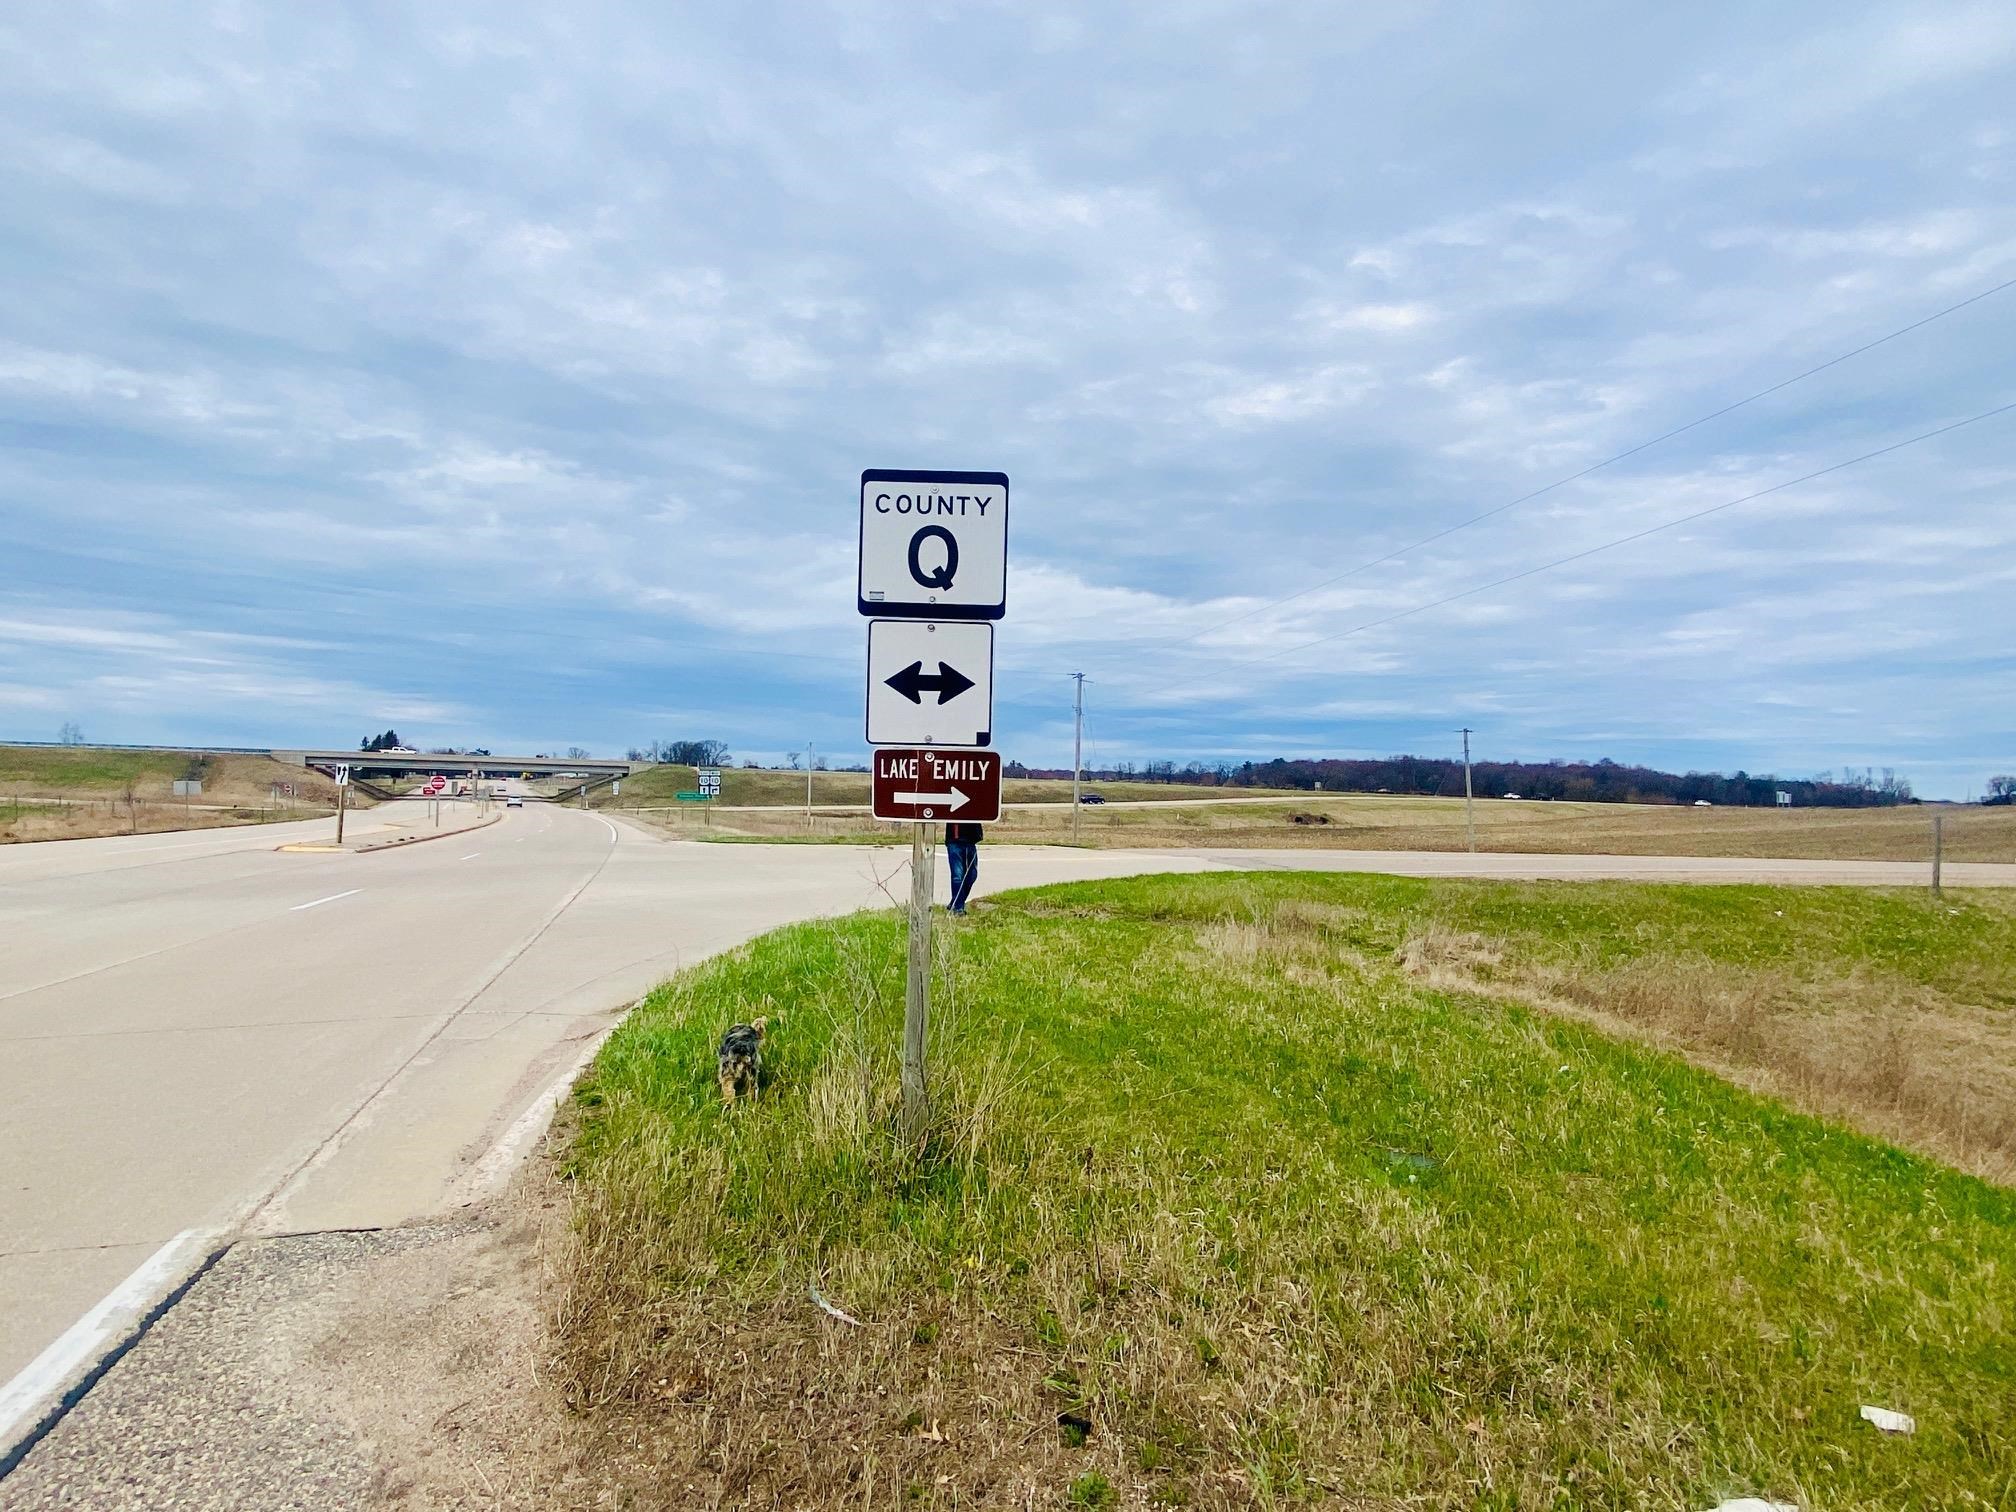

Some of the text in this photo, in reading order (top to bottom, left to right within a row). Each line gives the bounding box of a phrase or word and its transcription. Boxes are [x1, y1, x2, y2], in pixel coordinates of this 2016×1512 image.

[875, 493, 993, 516] COUNTY
[907, 524, 959, 592] Q
[880, 758, 990, 781] LAKE EMILY
